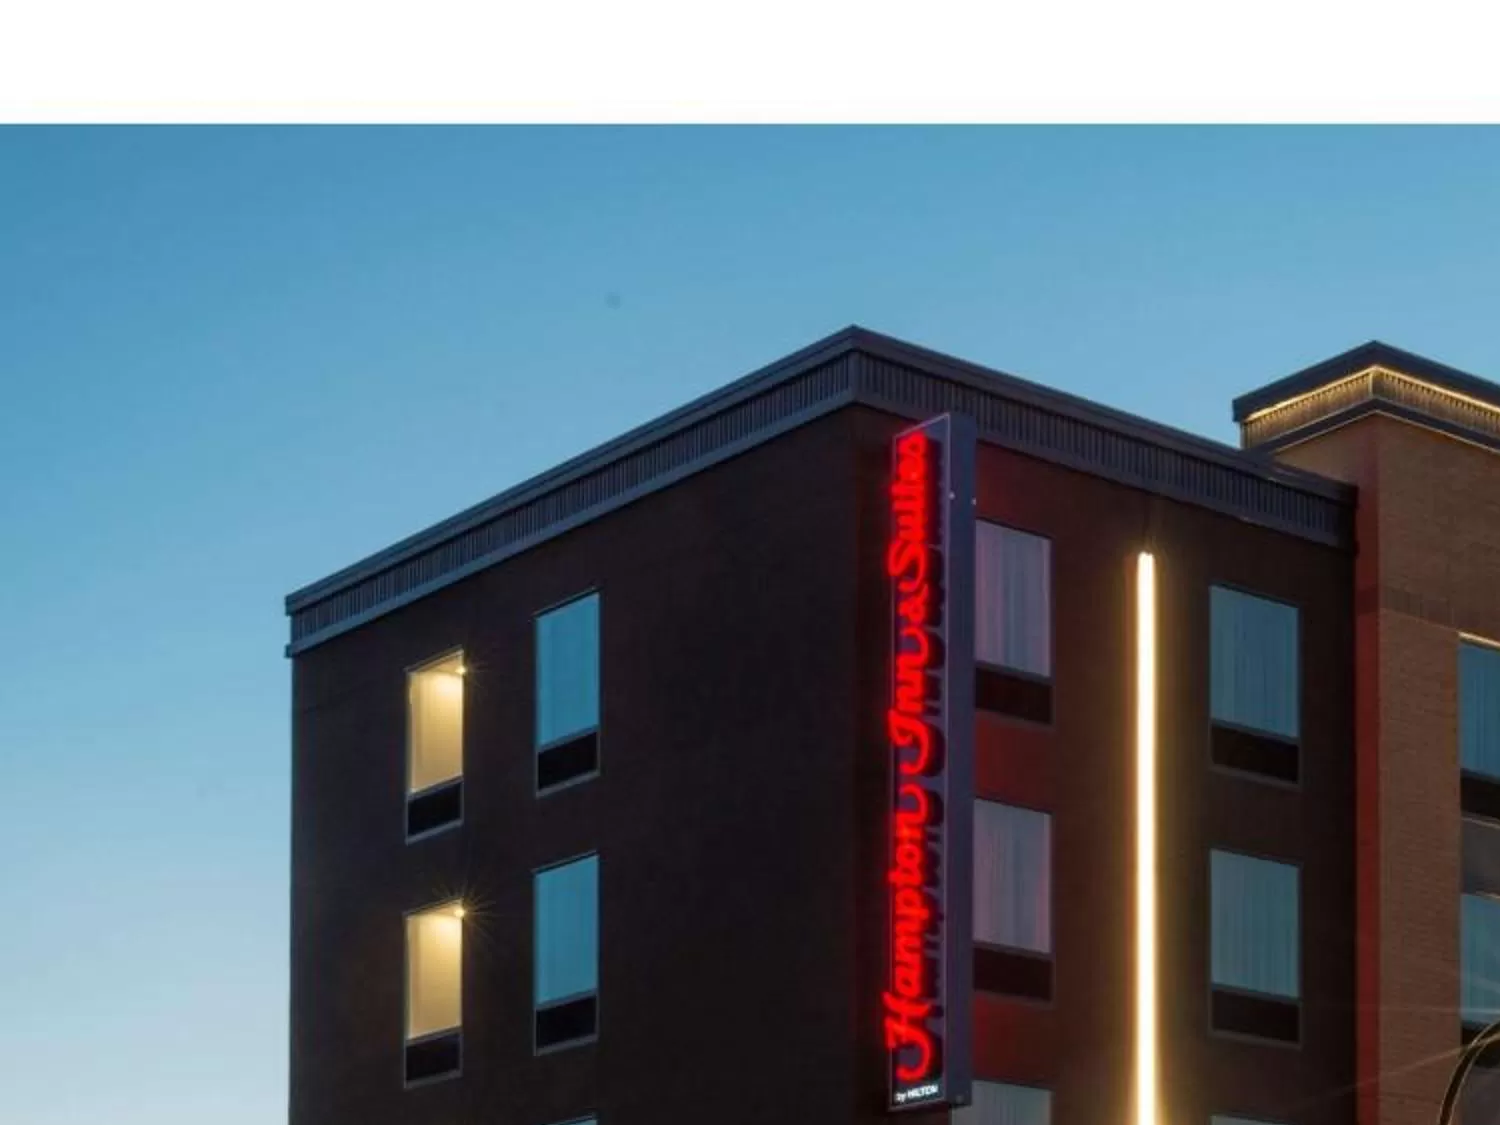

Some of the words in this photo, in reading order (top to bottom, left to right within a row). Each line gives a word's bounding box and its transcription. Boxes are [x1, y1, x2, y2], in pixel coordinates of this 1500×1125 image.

[888, 432, 928, 592] Suites
[898, 584, 929, 625] &
[888, 627, 930, 775] Inn
[882, 783, 932, 1082] Hampton
